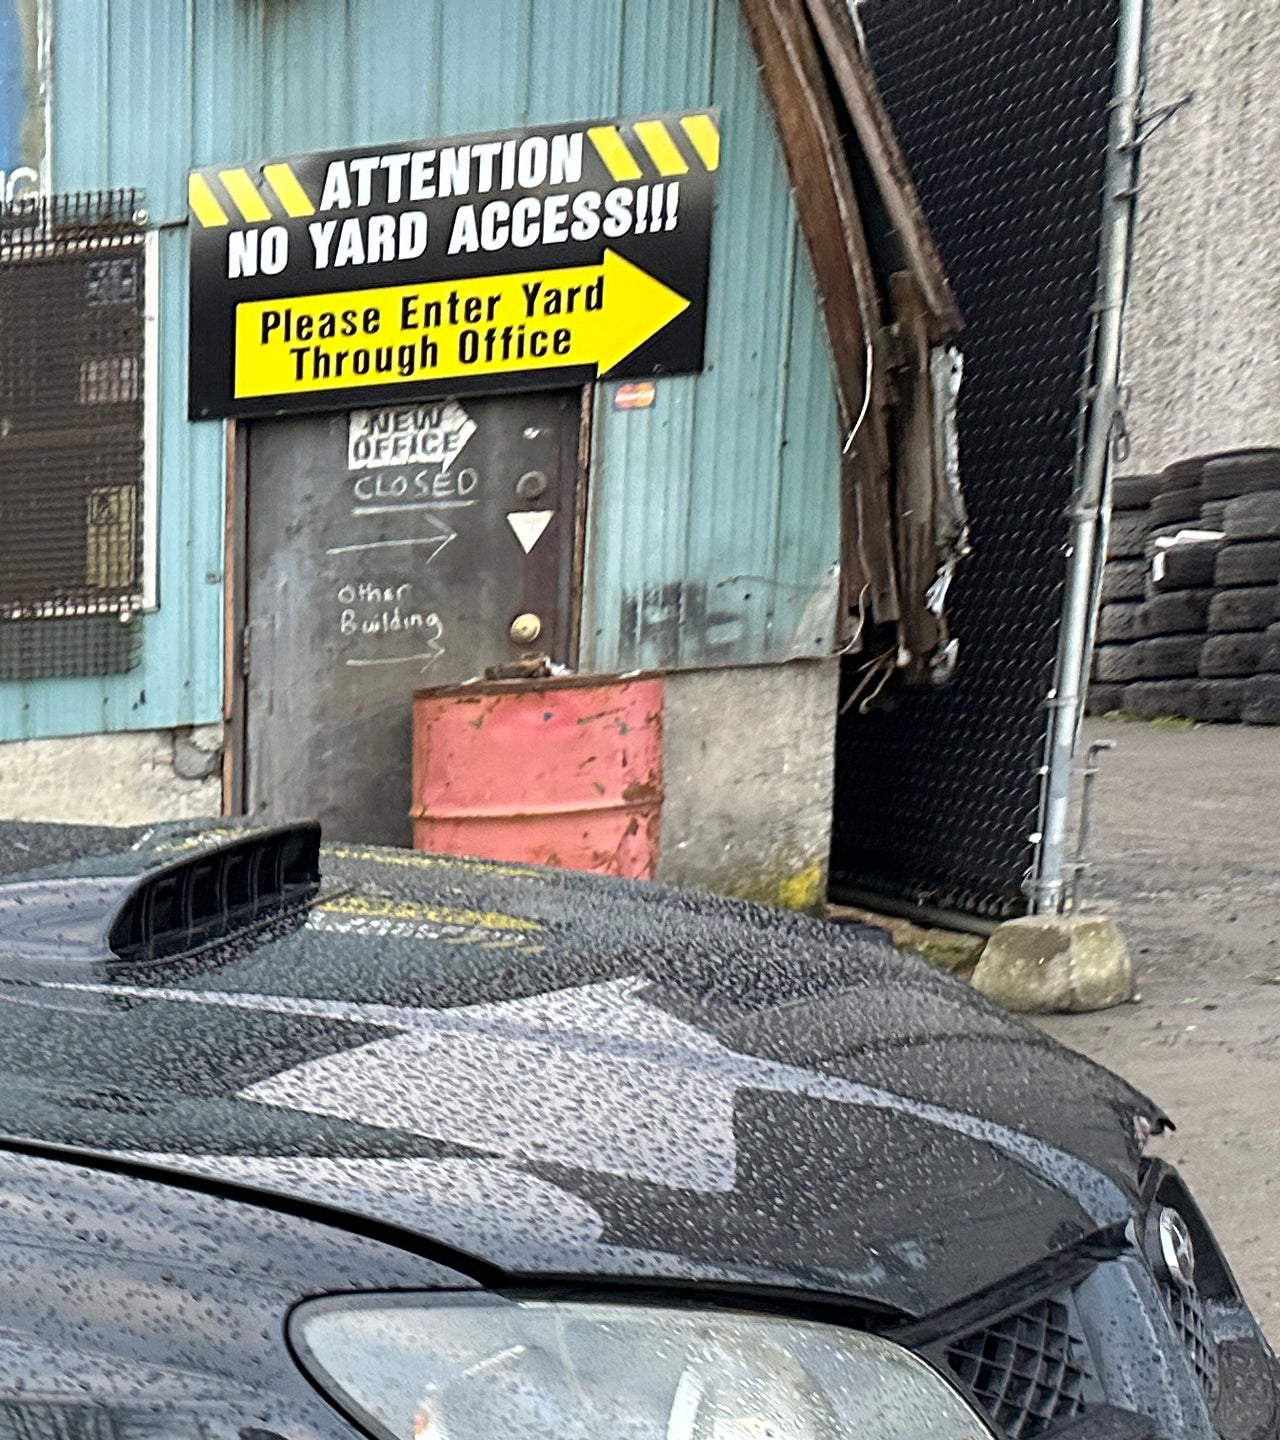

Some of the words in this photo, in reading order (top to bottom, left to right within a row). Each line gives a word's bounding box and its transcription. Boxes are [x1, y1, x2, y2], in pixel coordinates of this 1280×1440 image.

[319, 133, 584, 211] ATTENTION
[228, 226, 289, 279] NO
[309, 210, 428, 271] YARD
[447, 182, 680, 256] ACCESS!!!
[260, 304, 381, 345] Please
[400, 292, 503, 331] Enter
[520, 276, 605, 316] Yard
[290, 339, 438, 382] Through
[458, 326, 572, 364] Office
[369, 407, 441, 433] NEW
[352, 433, 461, 462] OFFICE
[353, 467, 480, 500] CLOSED
[341, 608, 443, 640] Building
